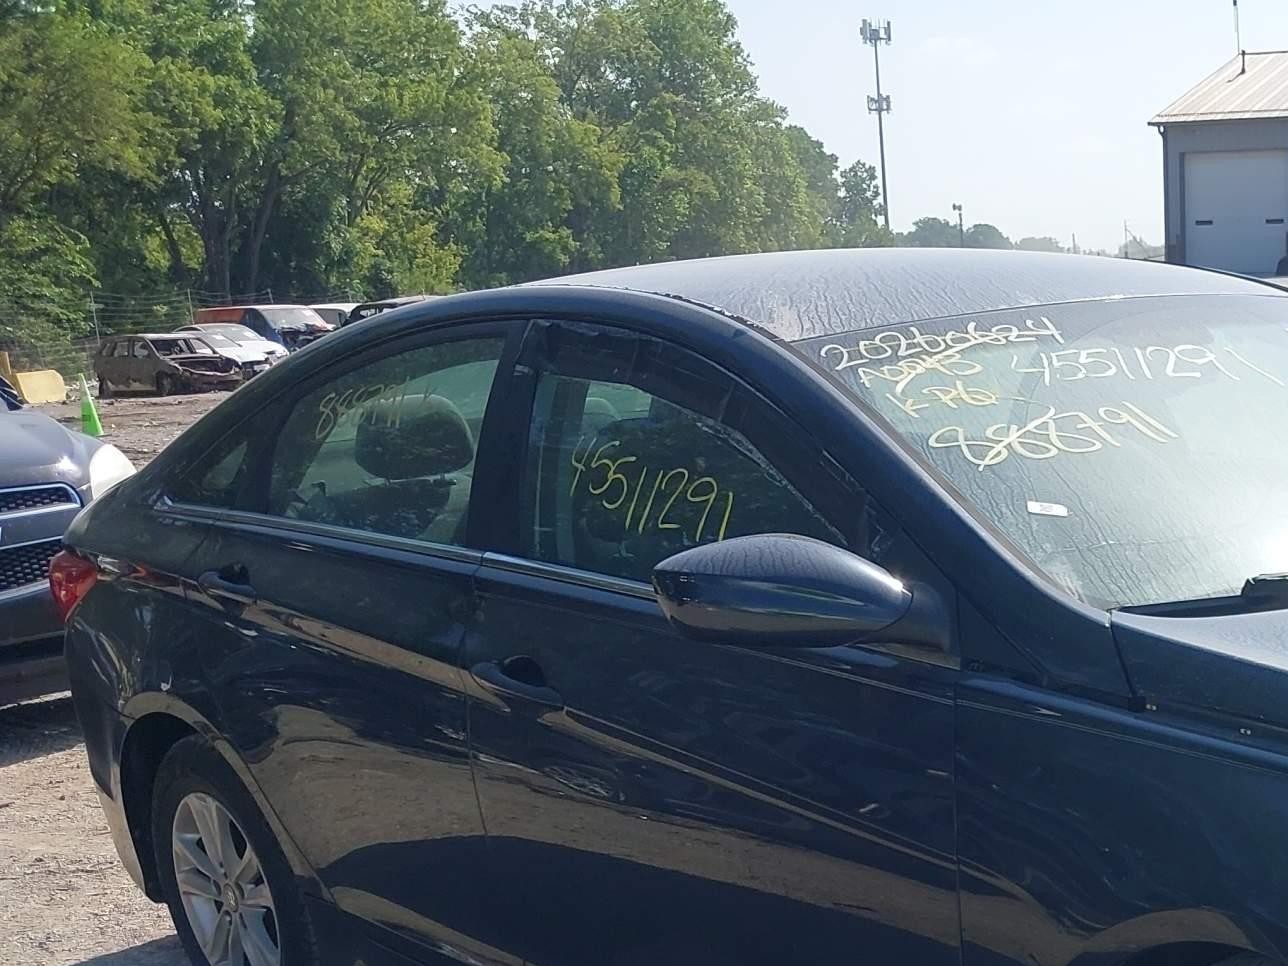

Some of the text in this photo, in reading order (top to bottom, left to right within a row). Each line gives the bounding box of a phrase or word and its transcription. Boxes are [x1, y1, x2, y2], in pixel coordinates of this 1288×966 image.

[820, 316, 1064, 370] 20260624
[1010, 344, 1285, 386] 45511291
[928, 401, 1179, 469] 888791
[569, 435, 734, 541] 45511291
